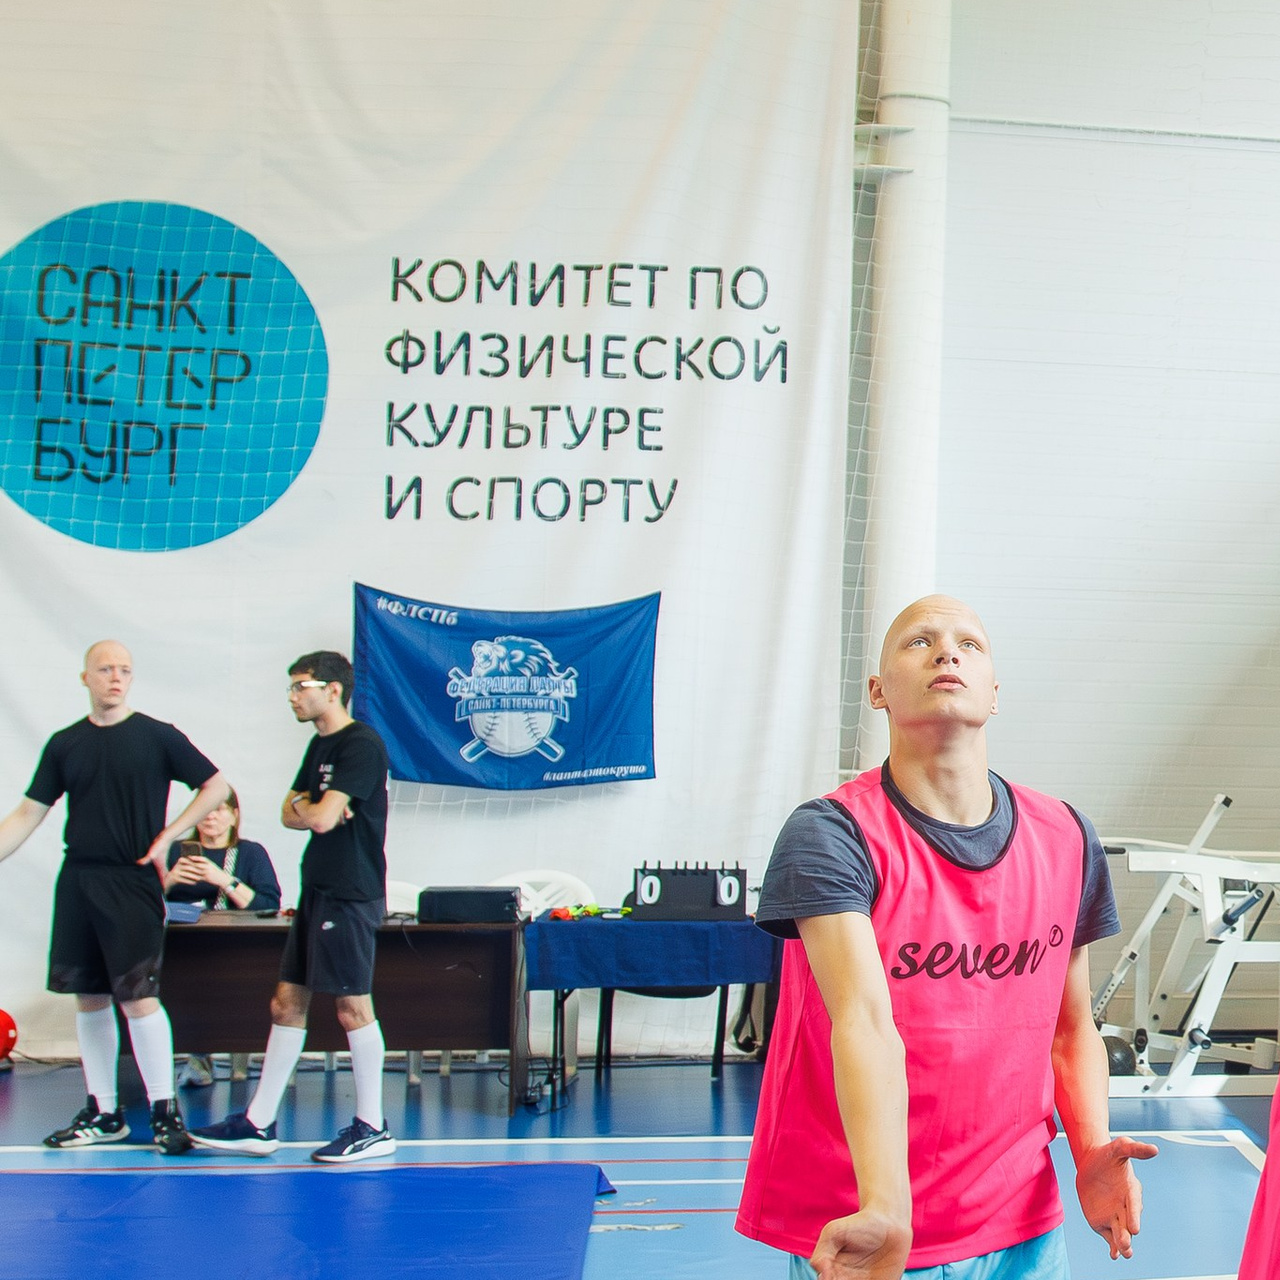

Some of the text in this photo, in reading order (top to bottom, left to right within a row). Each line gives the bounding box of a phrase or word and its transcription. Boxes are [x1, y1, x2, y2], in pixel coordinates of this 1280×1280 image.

[36, 263, 252, 336] САНКТ
[390, 256, 769, 310] КОМИТЕТ ПО
[33, 338, 252, 410] ПЕТЕР
[383, 324, 788, 383] ФИЗИЧЕСКОЙ
[33, 417, 208, 487] БУРГ
[385, 401, 665, 451] КУЛЬТУРЕ
[384, 474, 679, 523] И СПОРТУ
[377, 596, 458, 626] #ФЛСПб
[641, 875, 740, 905] 0 0
[890, 940, 1048, 981] seven
